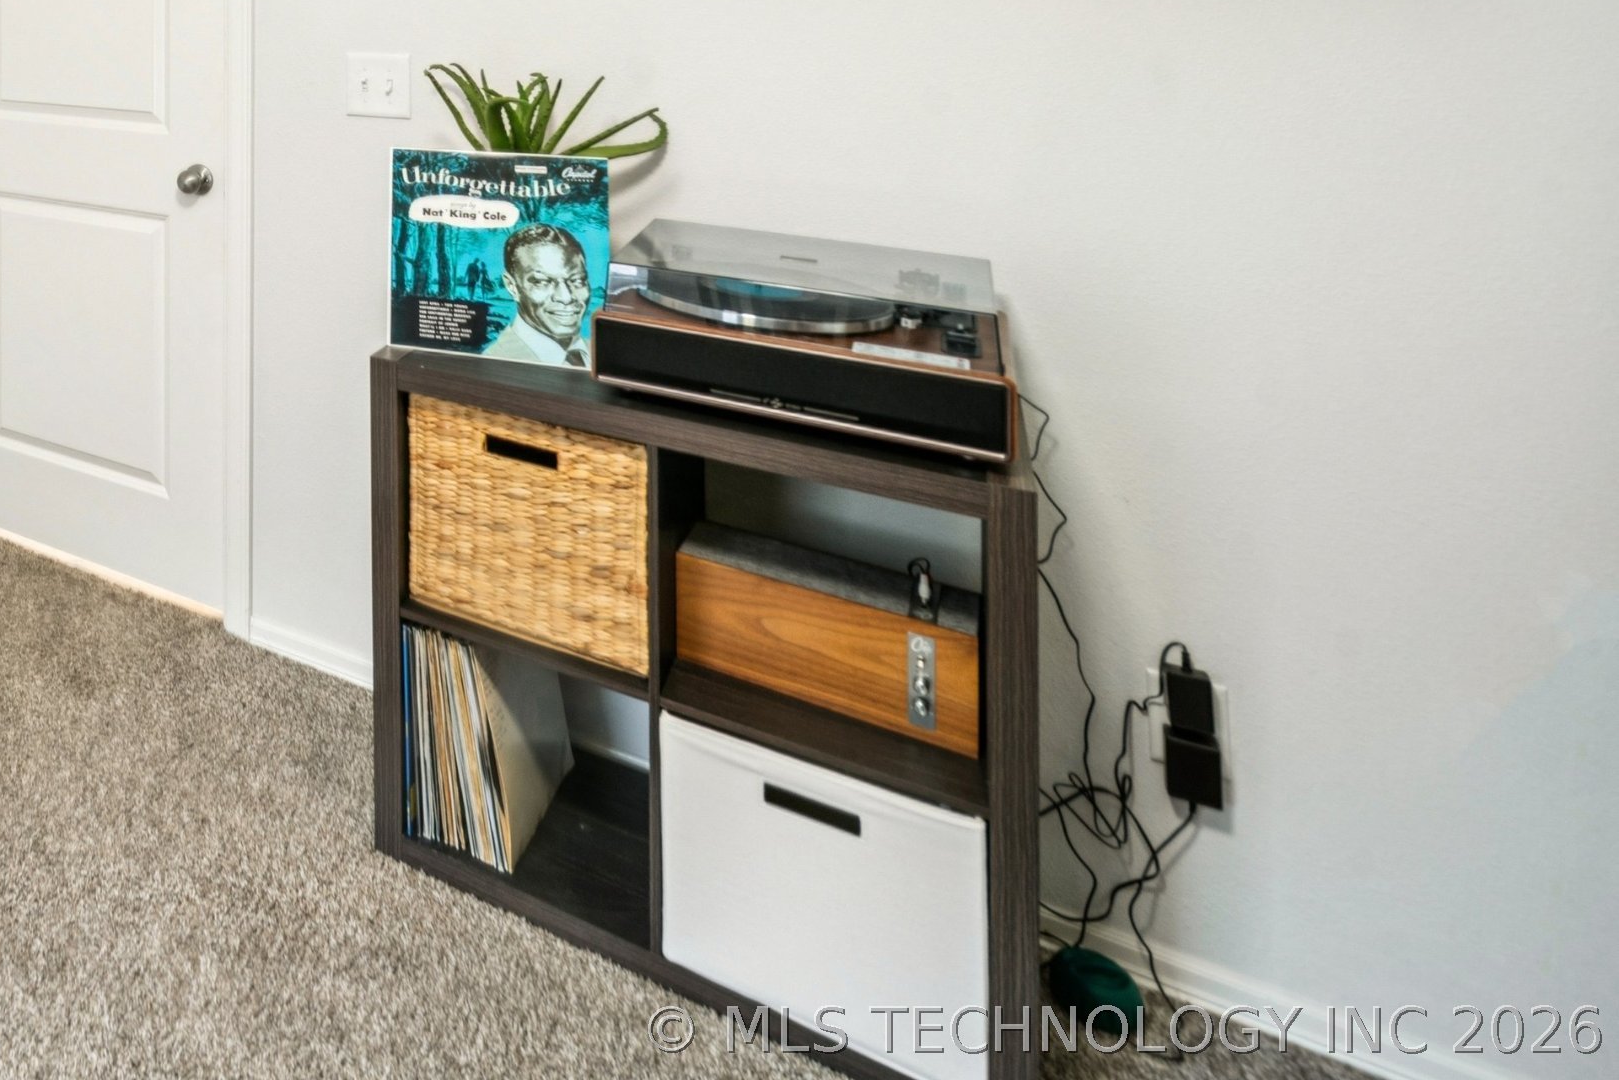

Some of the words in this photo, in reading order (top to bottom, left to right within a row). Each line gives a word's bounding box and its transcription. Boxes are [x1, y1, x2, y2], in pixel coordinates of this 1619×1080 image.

[401, 167, 571, 197] Unforgettable
[422, 207, 444, 217] Nat
[483, 211, 507, 221] Cole
